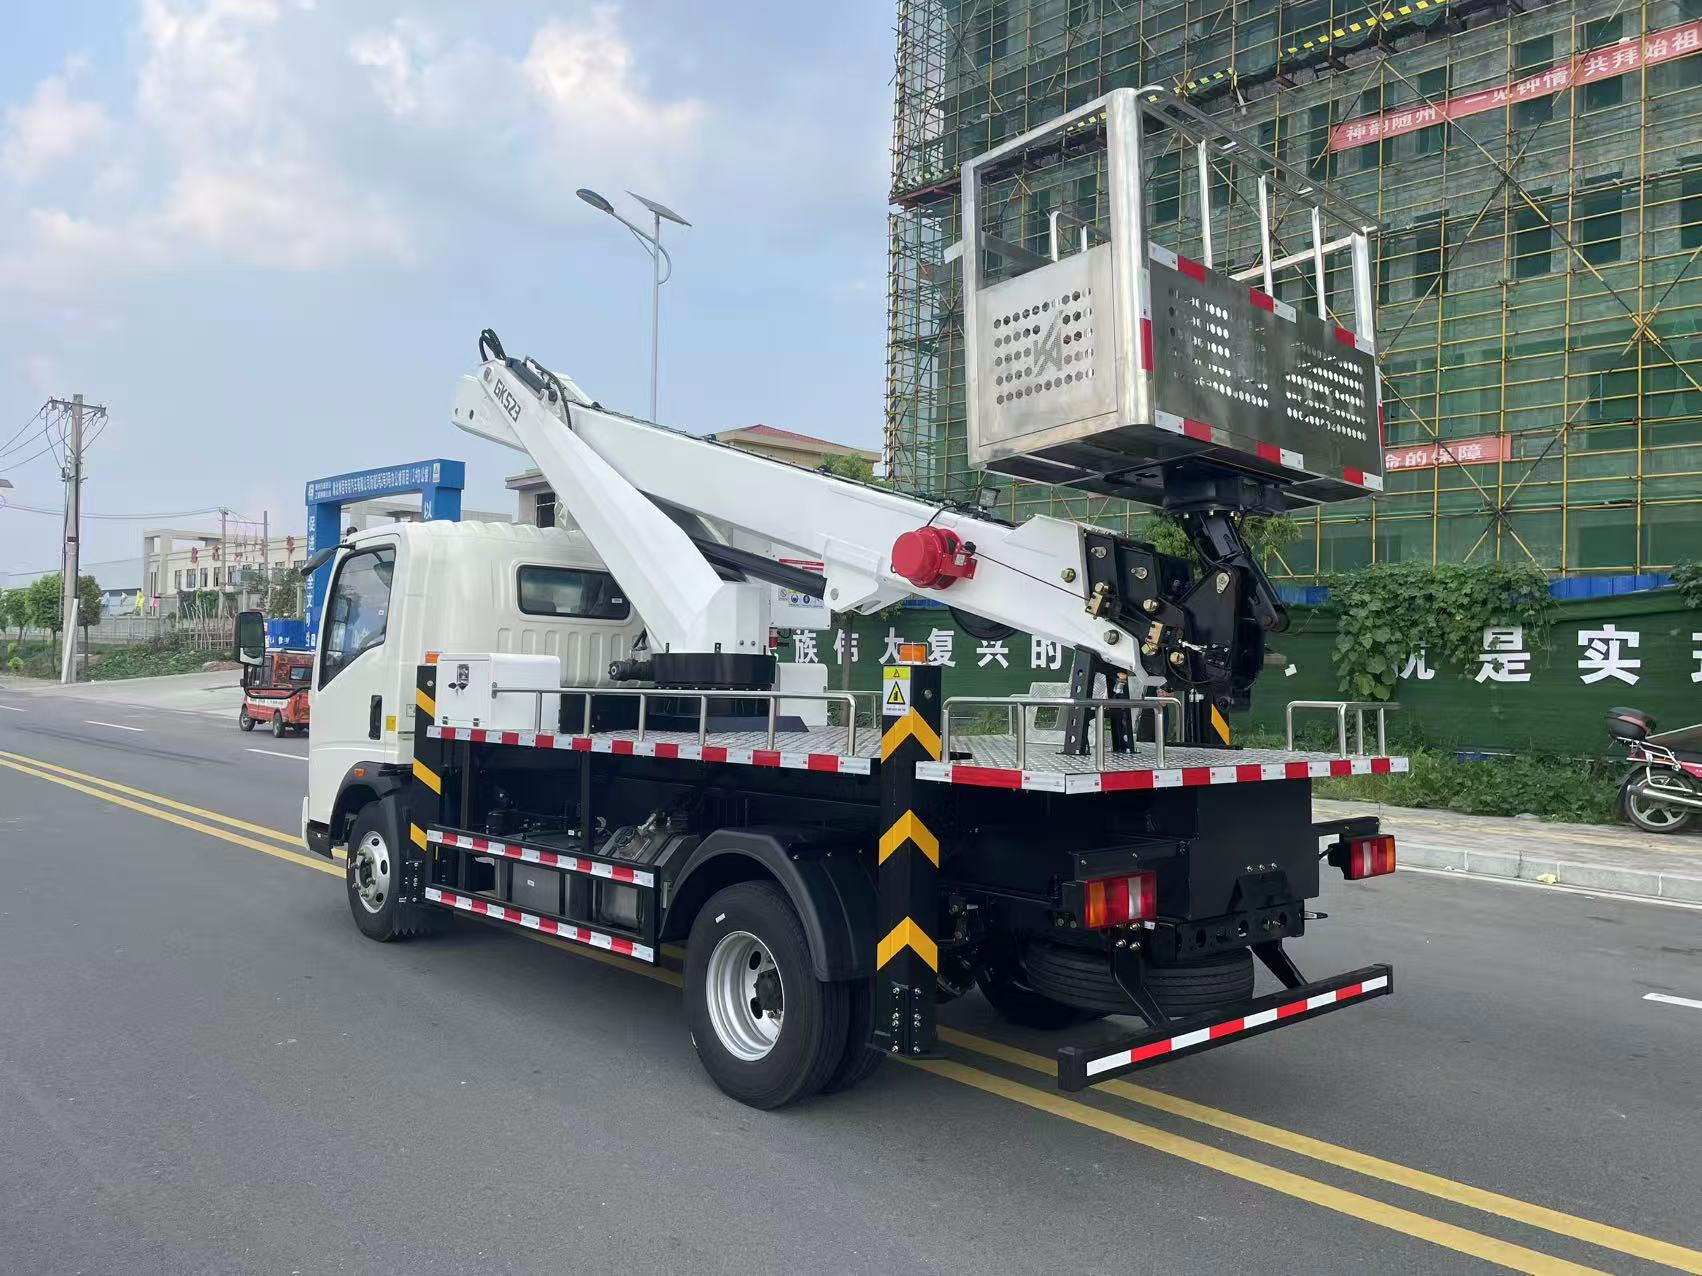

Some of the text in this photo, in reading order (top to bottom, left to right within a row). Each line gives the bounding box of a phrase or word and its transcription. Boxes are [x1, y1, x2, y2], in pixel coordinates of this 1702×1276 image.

[1584, 28, 1699, 76] 共拜始祖
[493, 378, 521, 423] GK523
[769, 627, 1062, 670] 族伟大复兴的
